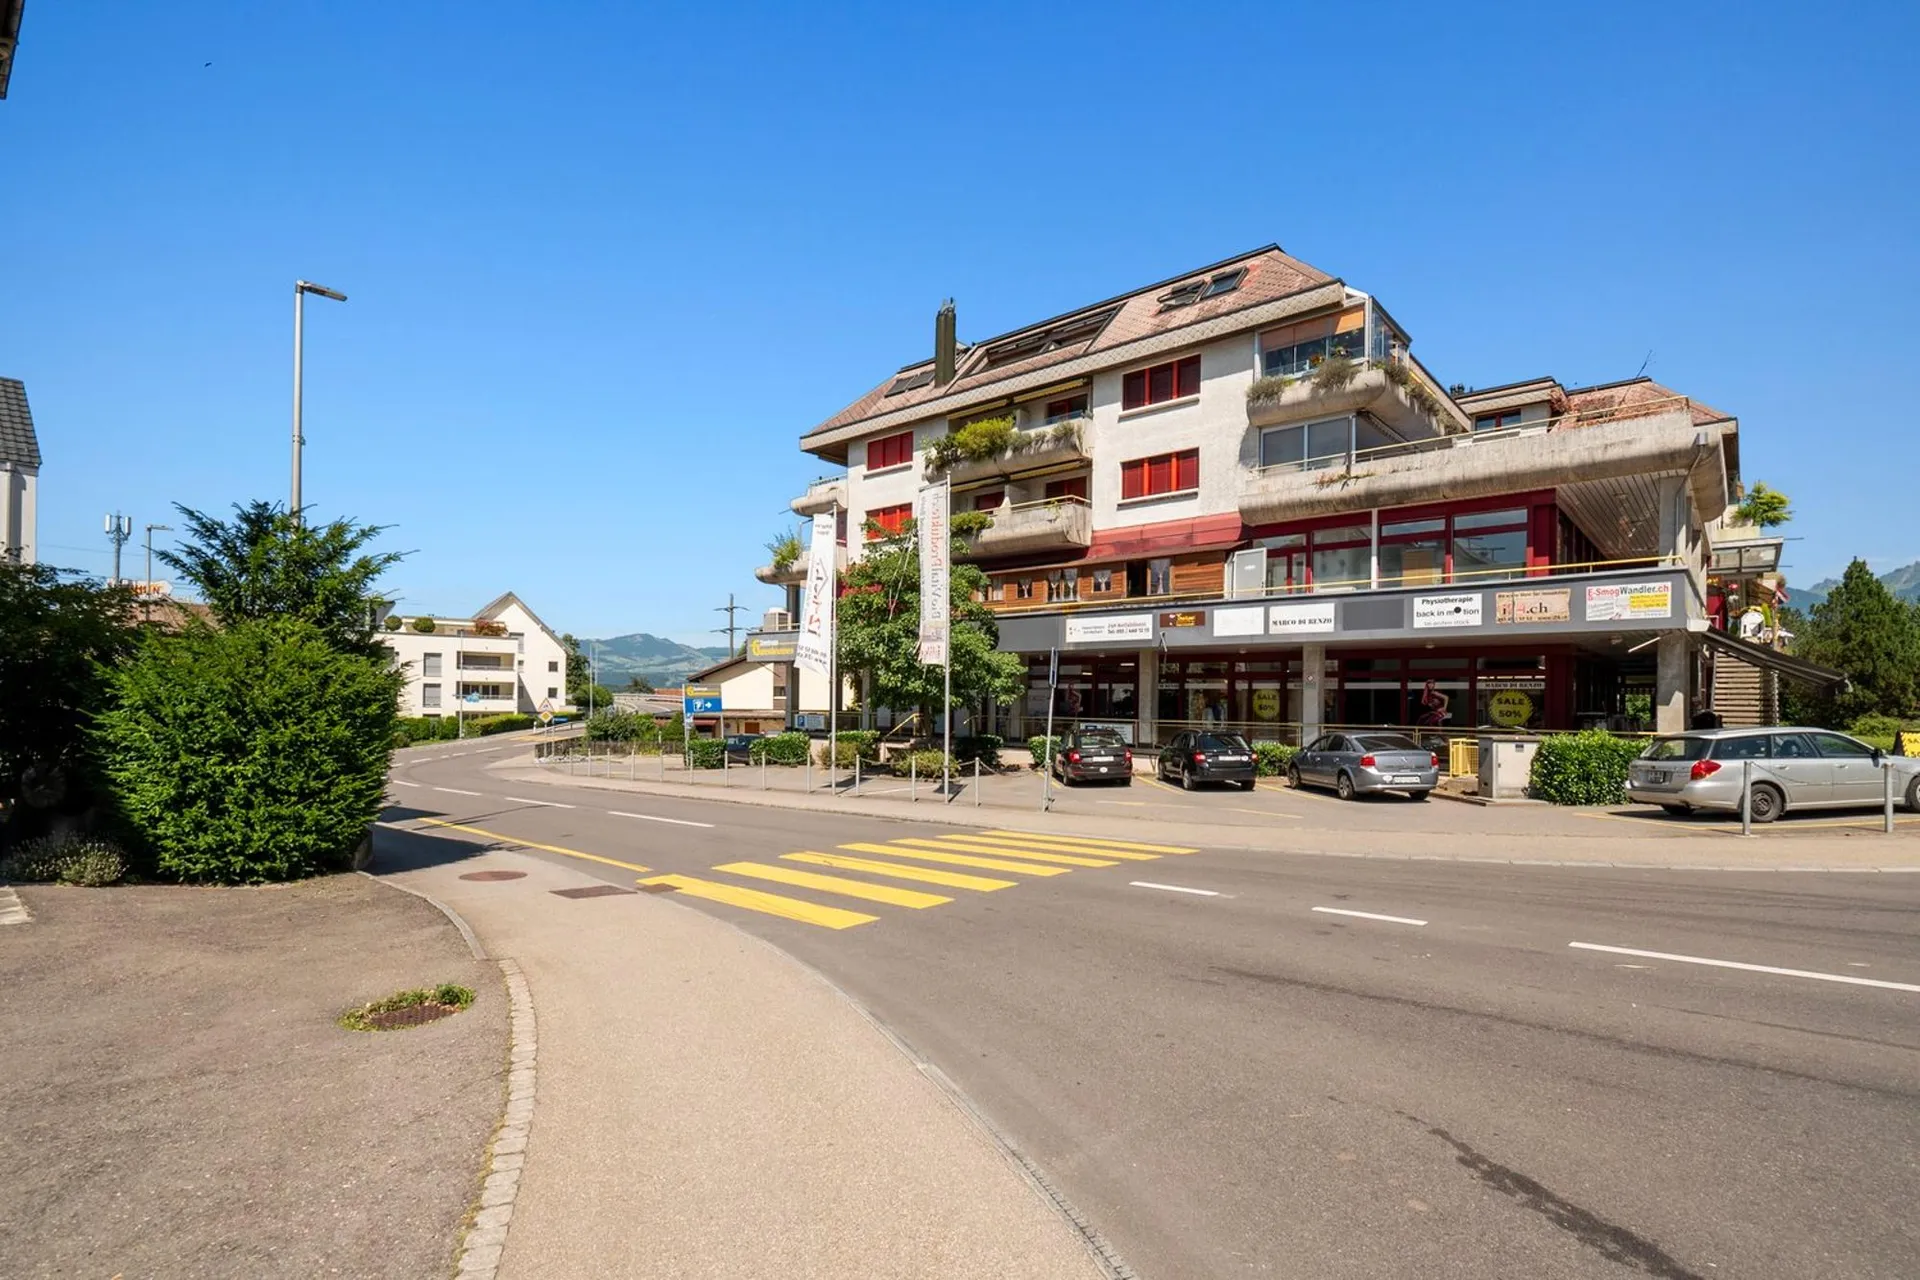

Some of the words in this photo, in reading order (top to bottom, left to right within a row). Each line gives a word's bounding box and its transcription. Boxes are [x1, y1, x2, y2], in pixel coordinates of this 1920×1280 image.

[1588, 584, 1669, 597] E-SmogWandler.ch
[1421, 596, 1474, 605] Physiotherapie
[1416, 610, 1435, 618] back
[1308, 617, 1332, 625] RENZO
[1256, 693, 1277, 701] SALE
[1496, 697, 1525, 705] SALE
[1257, 703, 1276, 711] 50%
[1498, 710, 1523, 718] 50%
